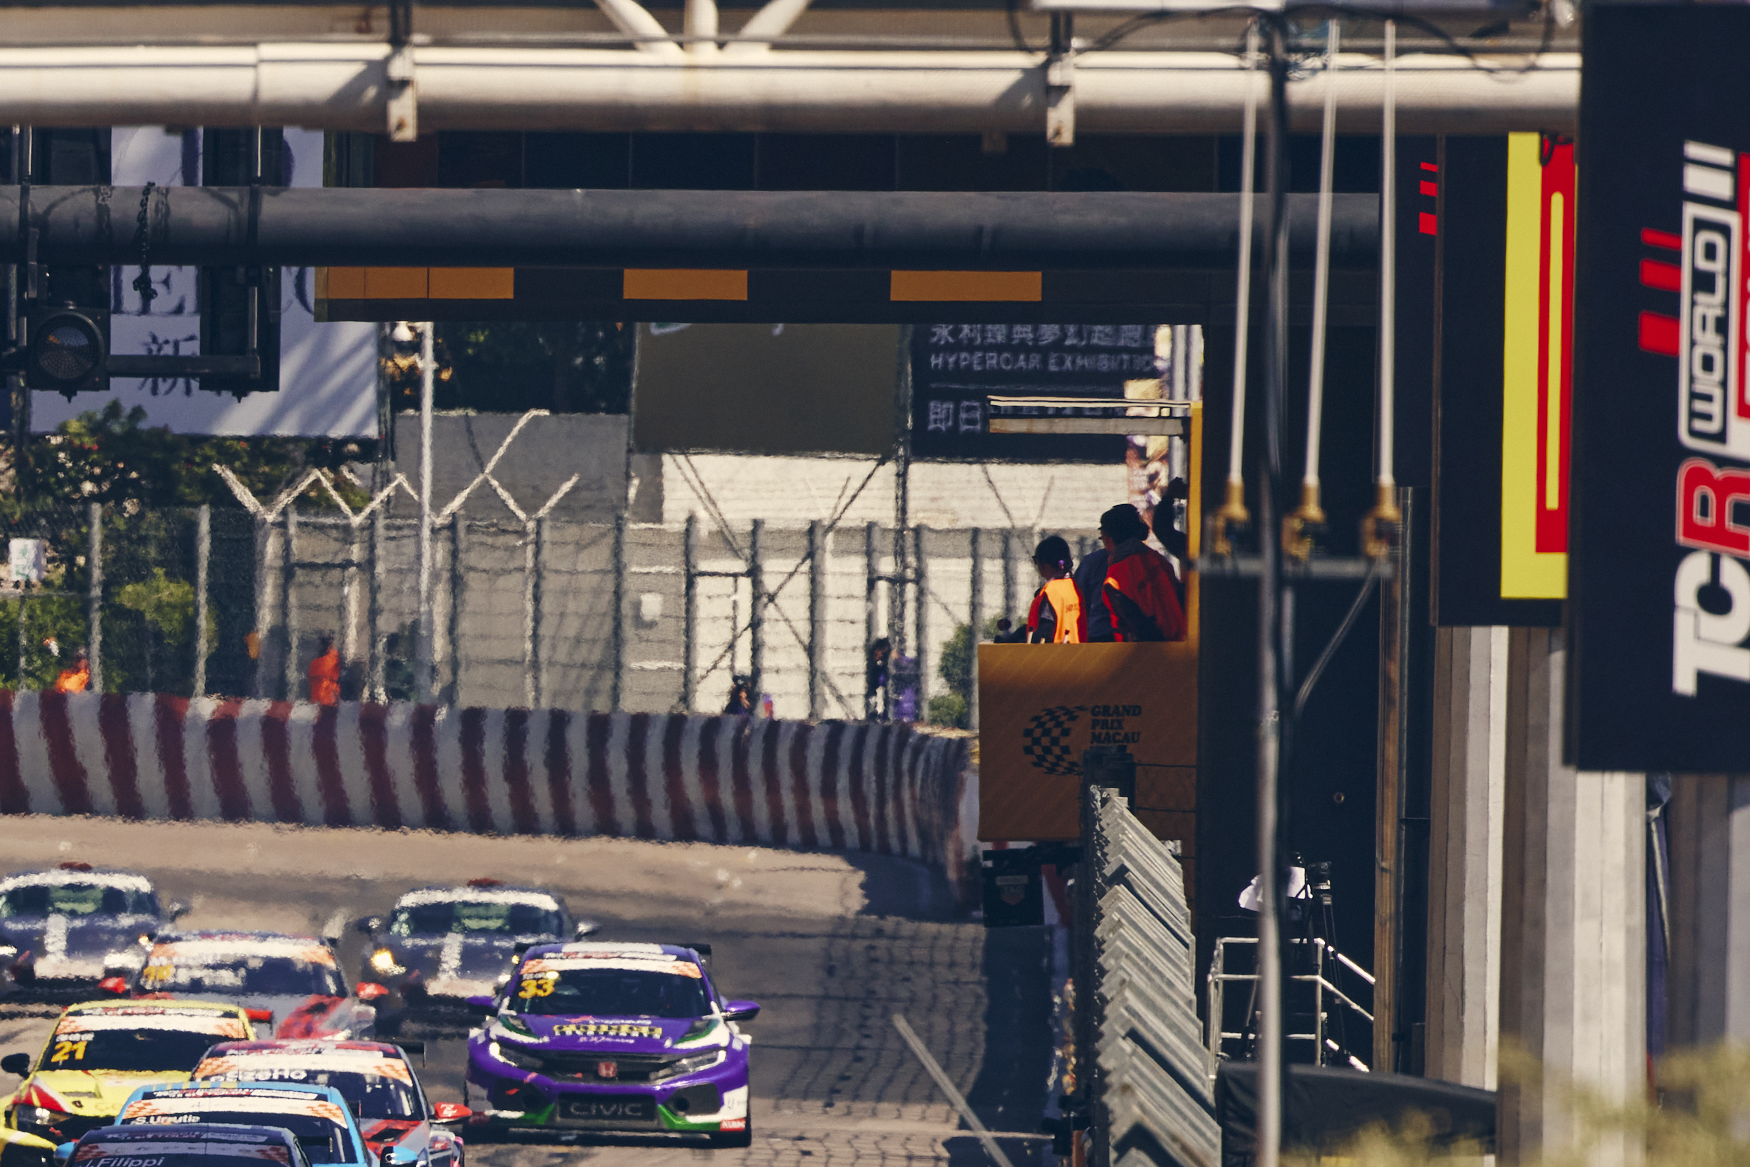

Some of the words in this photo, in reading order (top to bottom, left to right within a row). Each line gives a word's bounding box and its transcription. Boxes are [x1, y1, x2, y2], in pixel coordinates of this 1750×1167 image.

[1690, 229, 1727, 435] WORLD
[1671, 458, 1750, 696] TCR
[1090, 704, 1142, 718] GRAND
[1090, 718, 1124, 731] PRIX
[1090, 731, 1141, 744] MACAU
[518, 978, 555, 999] 33
[51, 1040, 88, 1063] 21
[568, 1101, 643, 1118] CIVIC
